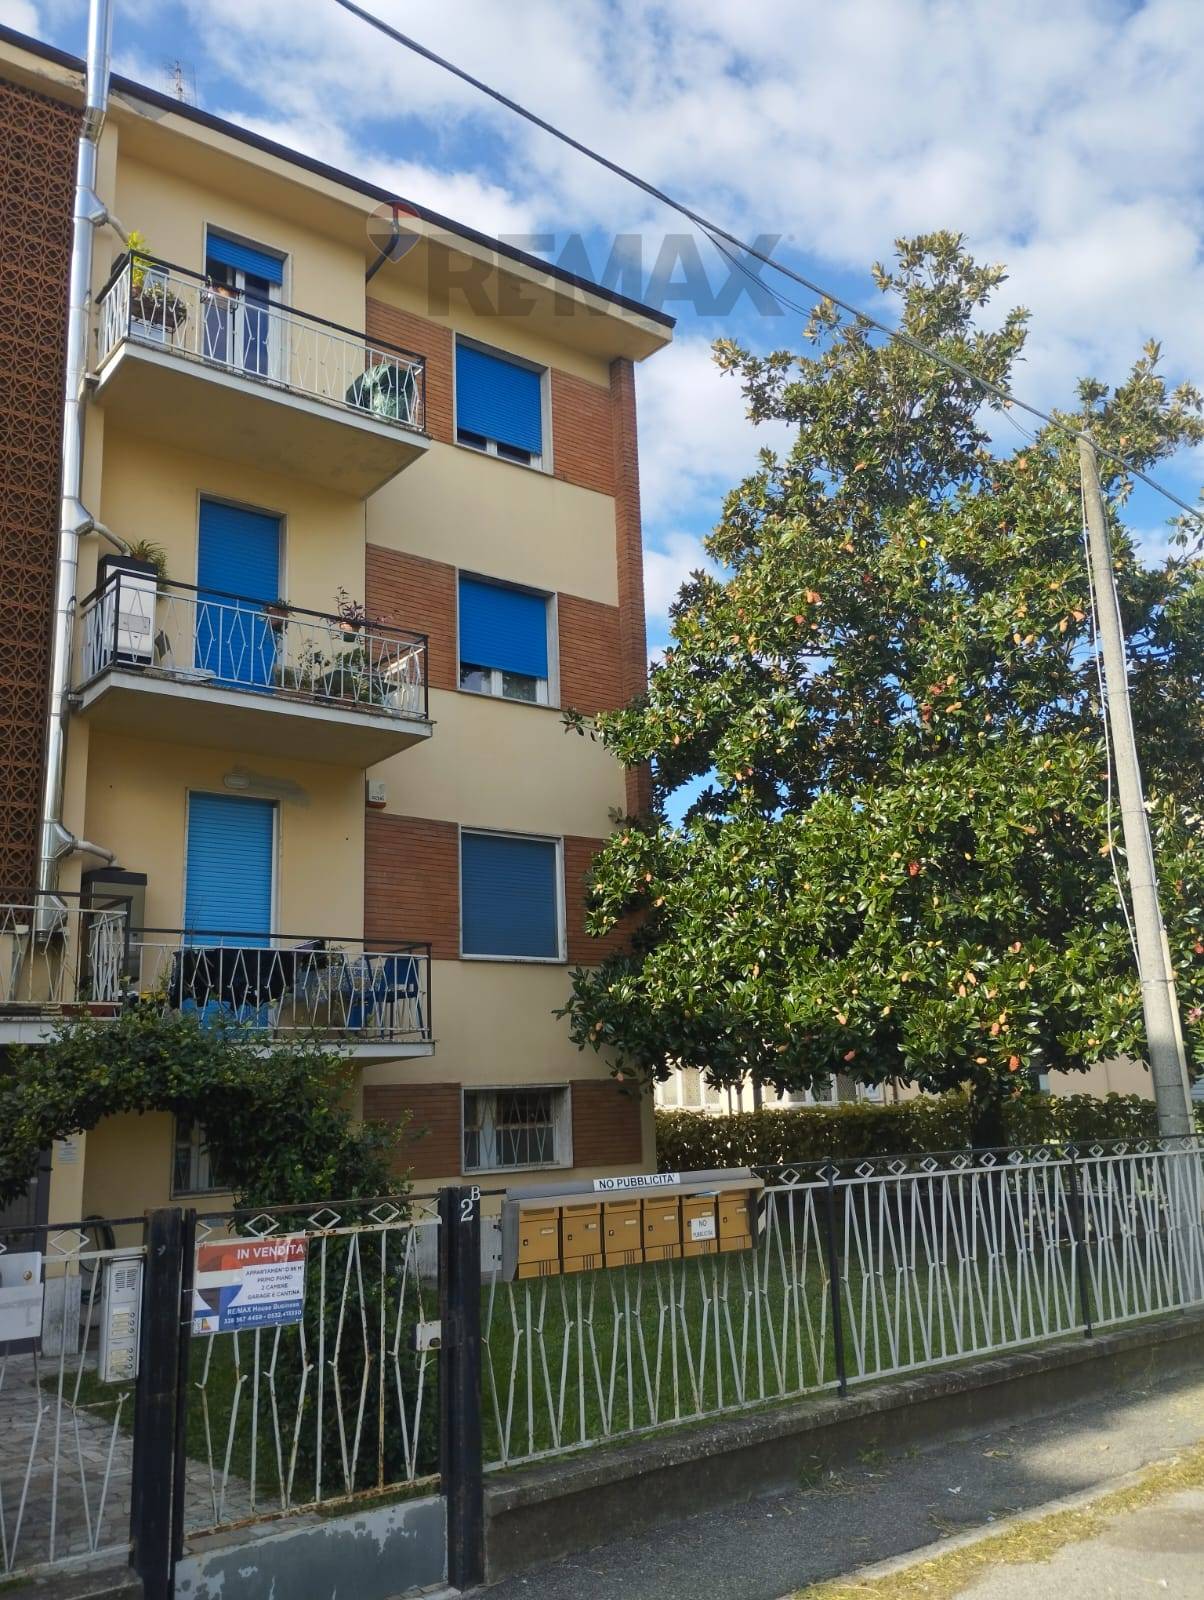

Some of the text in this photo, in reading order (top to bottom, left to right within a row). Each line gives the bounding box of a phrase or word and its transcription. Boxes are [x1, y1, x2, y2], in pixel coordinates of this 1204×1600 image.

[599, 1174, 675, 1189] NO PUBBLICITA'
[470, 1185, 481, 1201] B
[460, 1198, 474, 1222] 2
[698, 1219, 707, 1228] NO
[237, 1244, 304, 1260] IN VENDITA
[245, 1267, 289, 1276] APPARTAMENTO
[275, 1274, 293, 1282] PIANO
[247, 1292, 271, 1300] GARAGE
[275, 1289, 300, 1297] CANTINA
[252, 1304, 272, 1312] House
